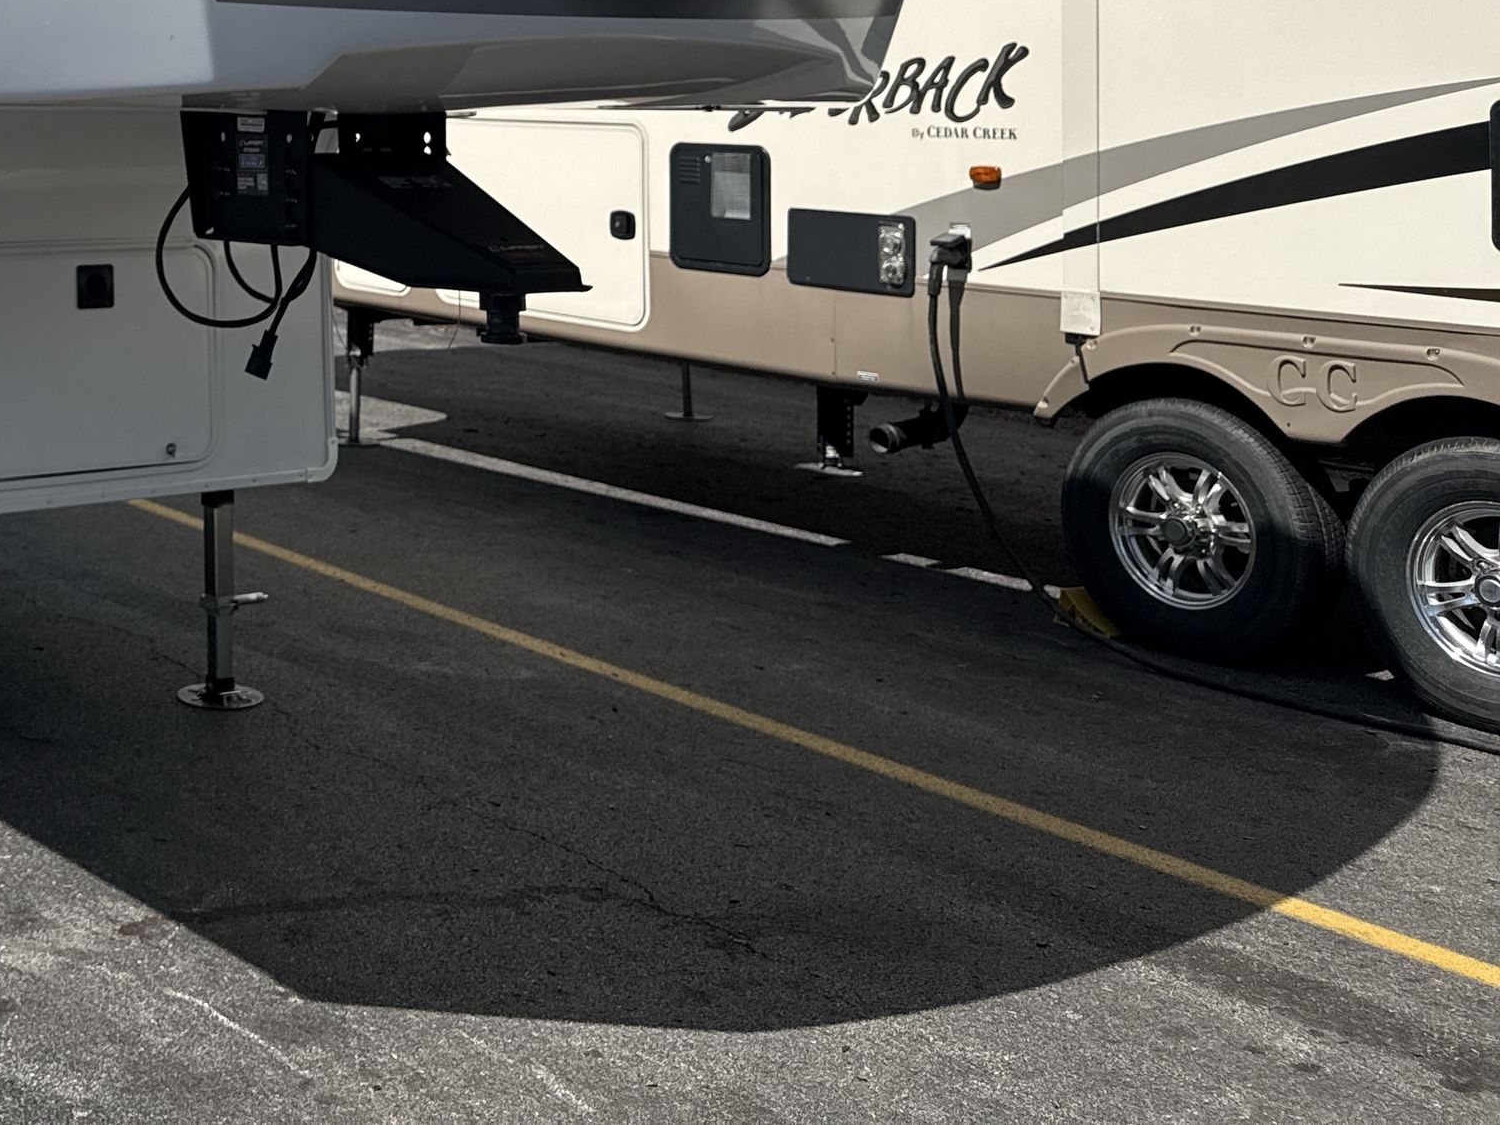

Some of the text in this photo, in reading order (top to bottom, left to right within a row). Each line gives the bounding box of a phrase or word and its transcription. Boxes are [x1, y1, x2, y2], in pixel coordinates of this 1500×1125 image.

[728, 42, 1030, 132] RBACK
[926, 125, 970, 139] CEDAR
[972, 126, 1018, 140] CREEK
